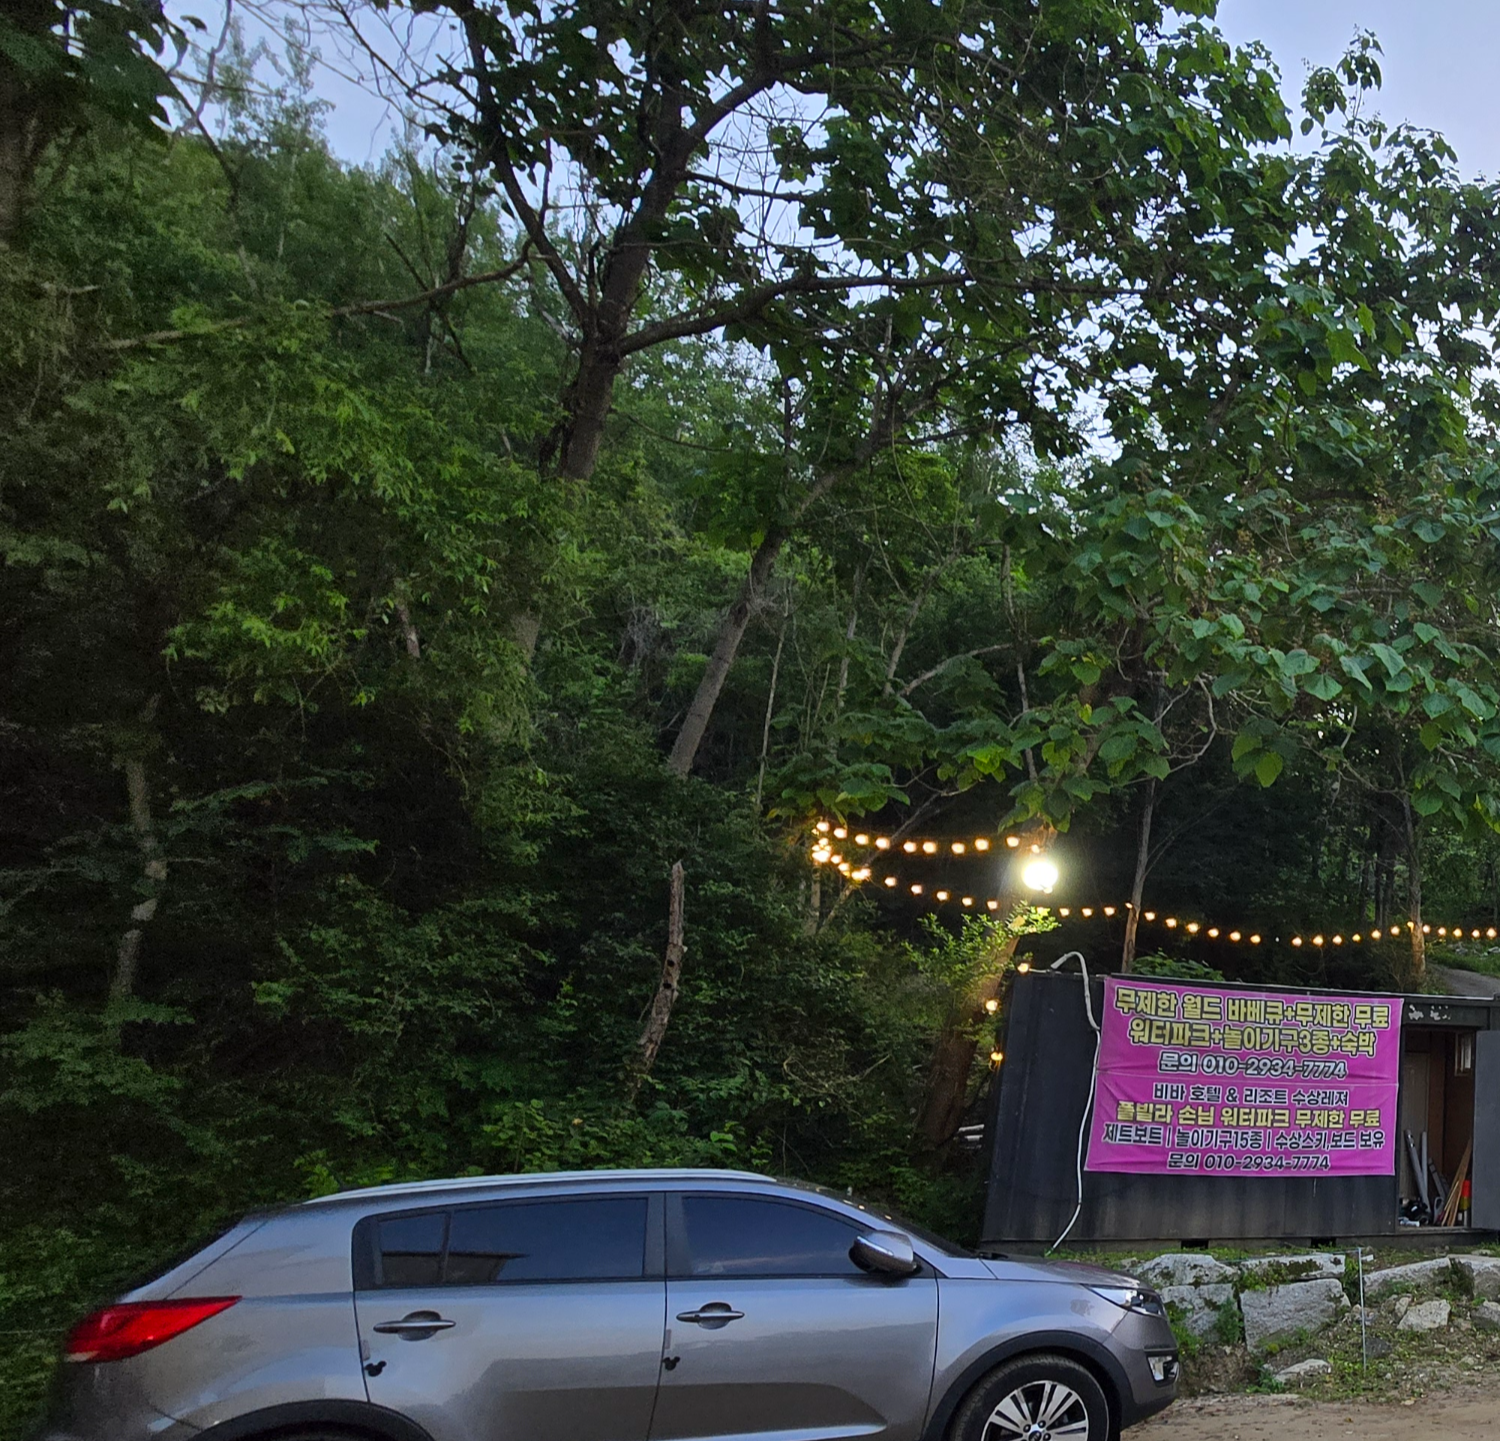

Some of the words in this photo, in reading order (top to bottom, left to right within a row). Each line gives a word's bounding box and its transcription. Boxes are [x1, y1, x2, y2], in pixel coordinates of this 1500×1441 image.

[1116, 988, 1177, 1017] 무제한
[1183, 995, 1222, 1020] 월드
[1228, 998, 1351, 1028] 바베큐+무제한
[1354, 1005, 1389, 1029] 무료
[1130, 1019, 1376, 1056] 워터파크+놀이기구3종+숙박
[1160, 1052, 1198, 1072] 문의
[1202, 1055, 1347, 1078] 010-2934-7774
[1154, 1083, 1186, 1101] 비바
[1189, 1085, 1221, 1102] 호텔
[1226, 1087, 1238, 1103] &
[1244, 1088, 1288, 1104] 리조트
[1292, 1090, 1348, 1106] 수상레져
[1178, 1105, 1214, 1126] 손님
[1220, 1107, 1290, 1127] 워터파크
[1295, 1109, 1345, 1128] 무제한
[1350, 1110, 1380, 1128] 무료
[1103, 1123, 1162, 1145] 제트보트
[1176, 1128, 1263, 1149] 놀이기구15종
[1275, 1131, 1355, 1151] 수상스키,보드
[1360, 1131, 1384, 1149] 보유
[1168, 1152, 1199, 1169] 문의
[1204, 1154, 1330, 1171] 010-2934-7774
